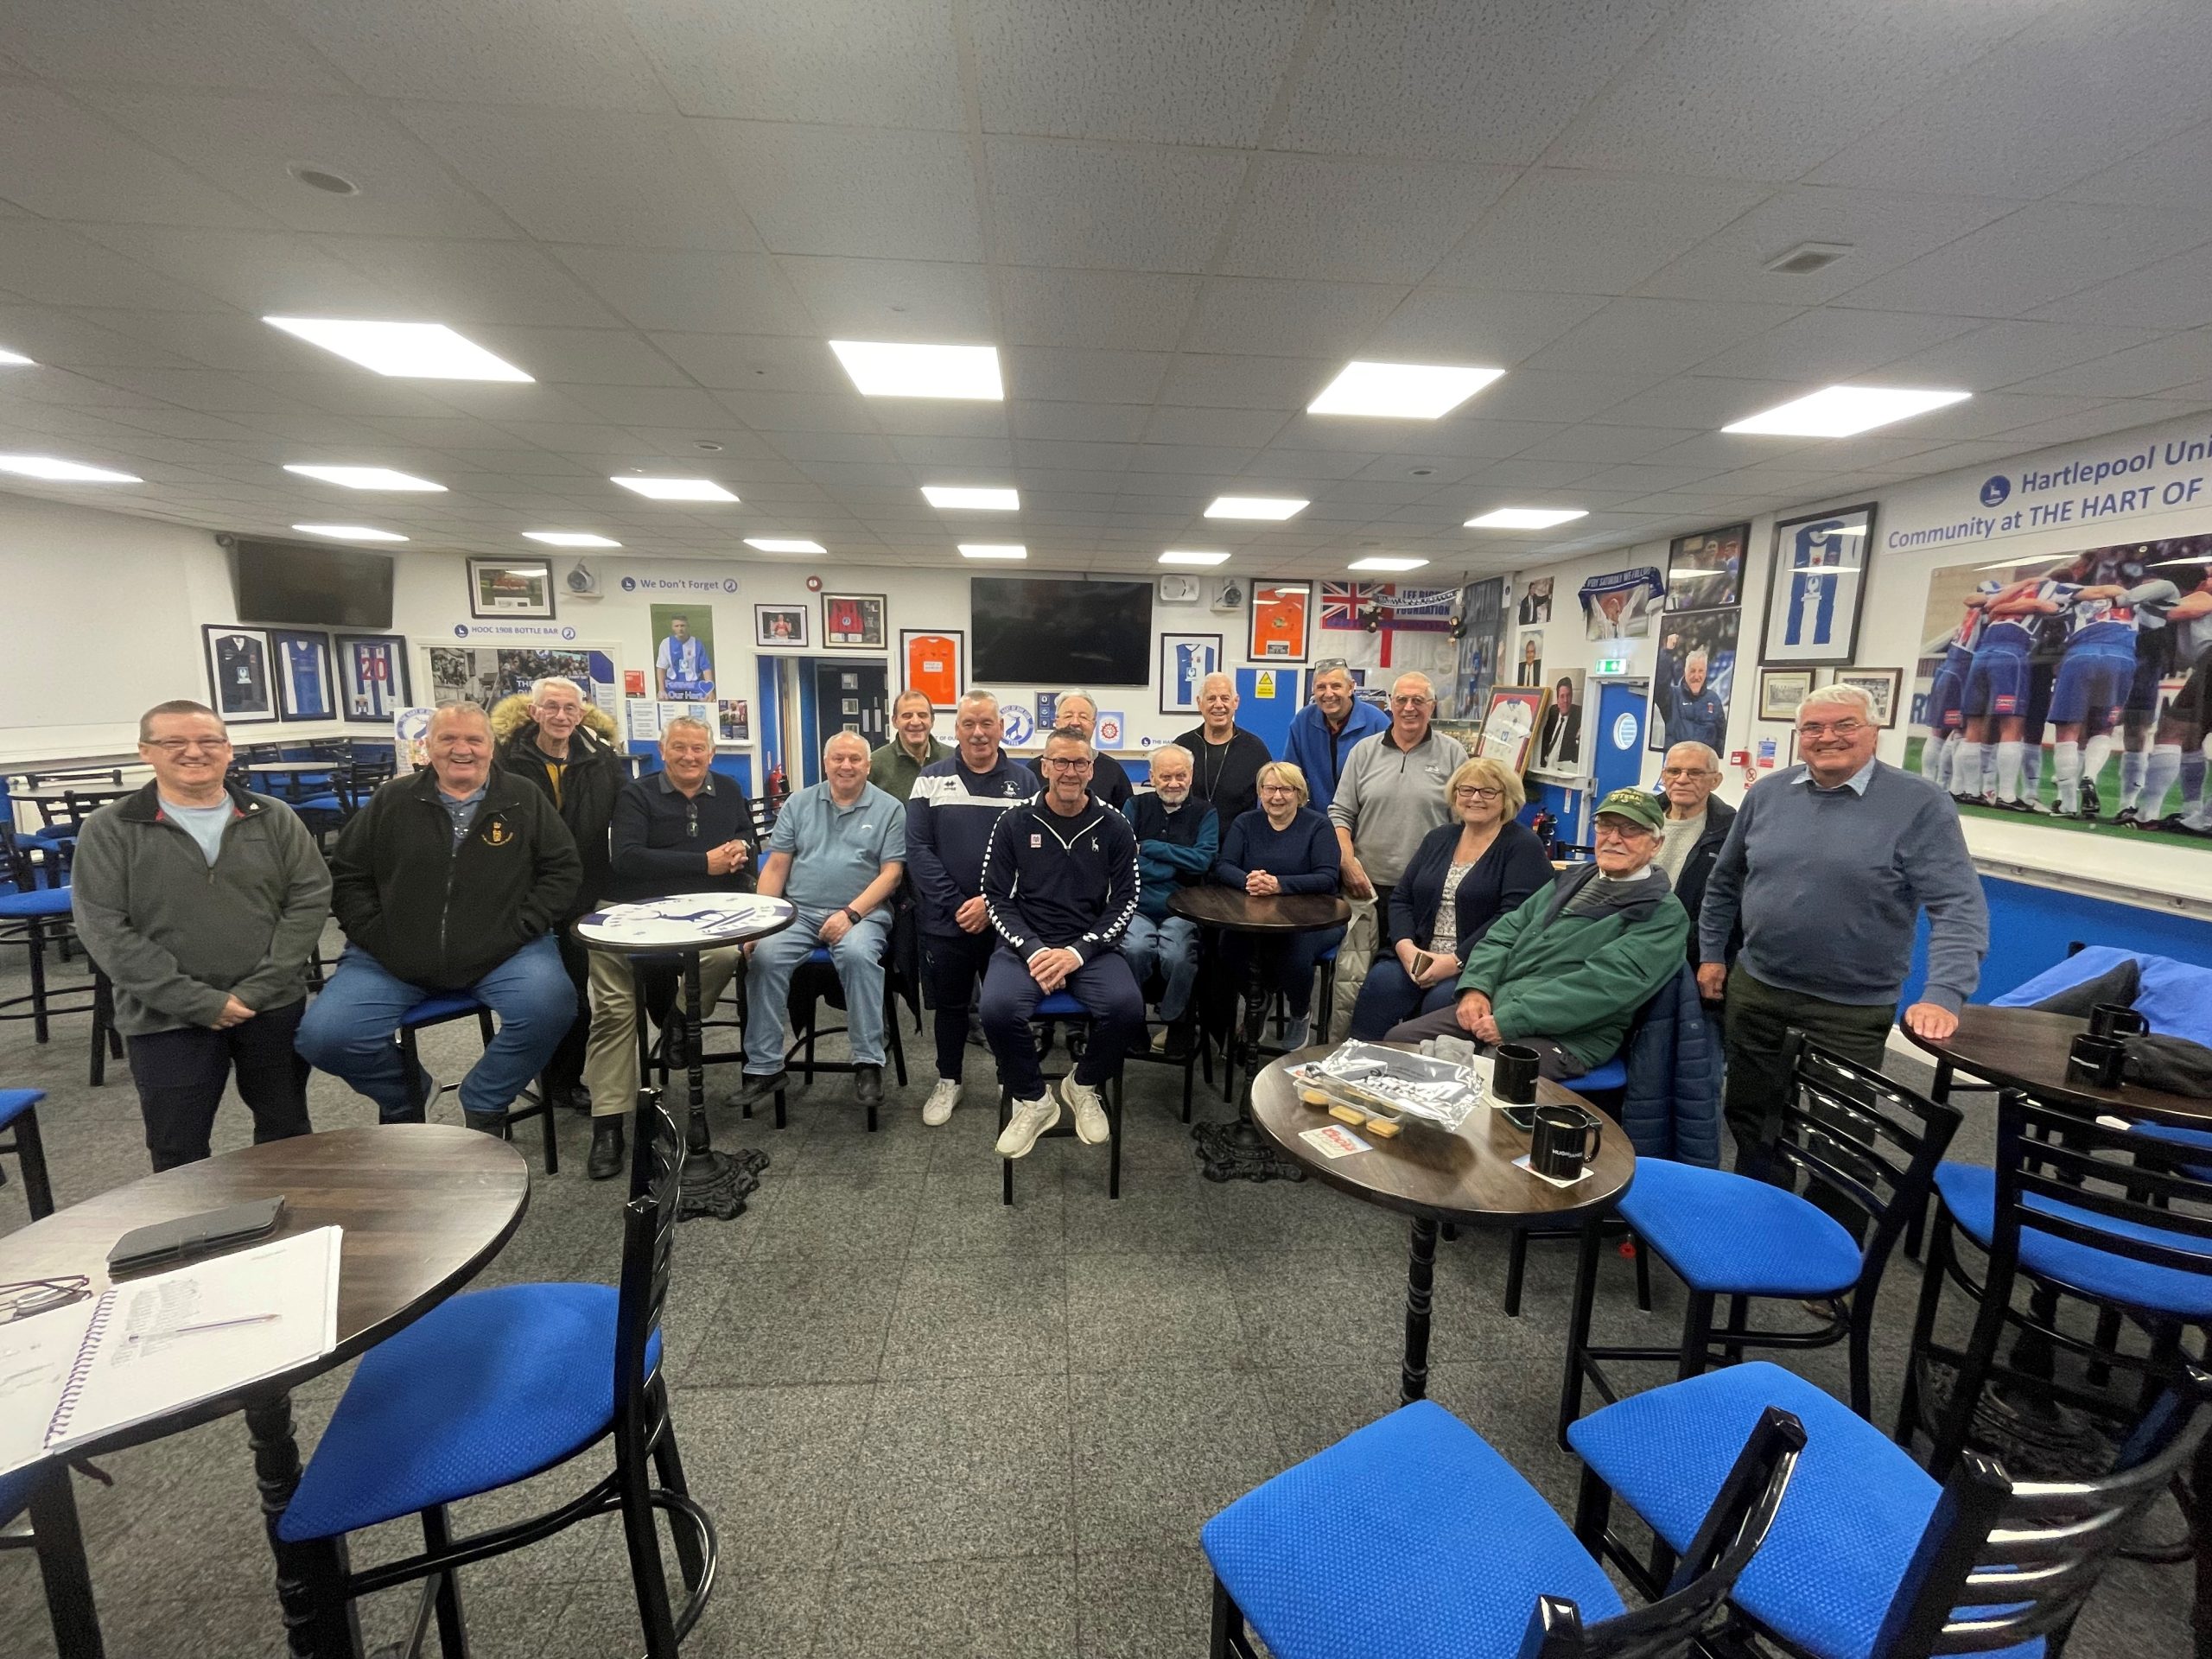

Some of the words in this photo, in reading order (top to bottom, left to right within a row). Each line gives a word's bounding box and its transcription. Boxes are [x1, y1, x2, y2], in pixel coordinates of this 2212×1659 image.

[2021, 444, 2156, 494] Hartlepool
[1888, 517, 1997, 550] Community
[2000, 511, 2023, 531] at
[2030, 500, 2074, 526] THE
[2081, 486, 2155, 518] HART
[2162, 477, 2203, 505] OF
[639, 579, 657, 588] We
[659, 580, 686, 588] Don't
[689, 581, 719, 591] Forget
[360, 657, 388, 681] 20
